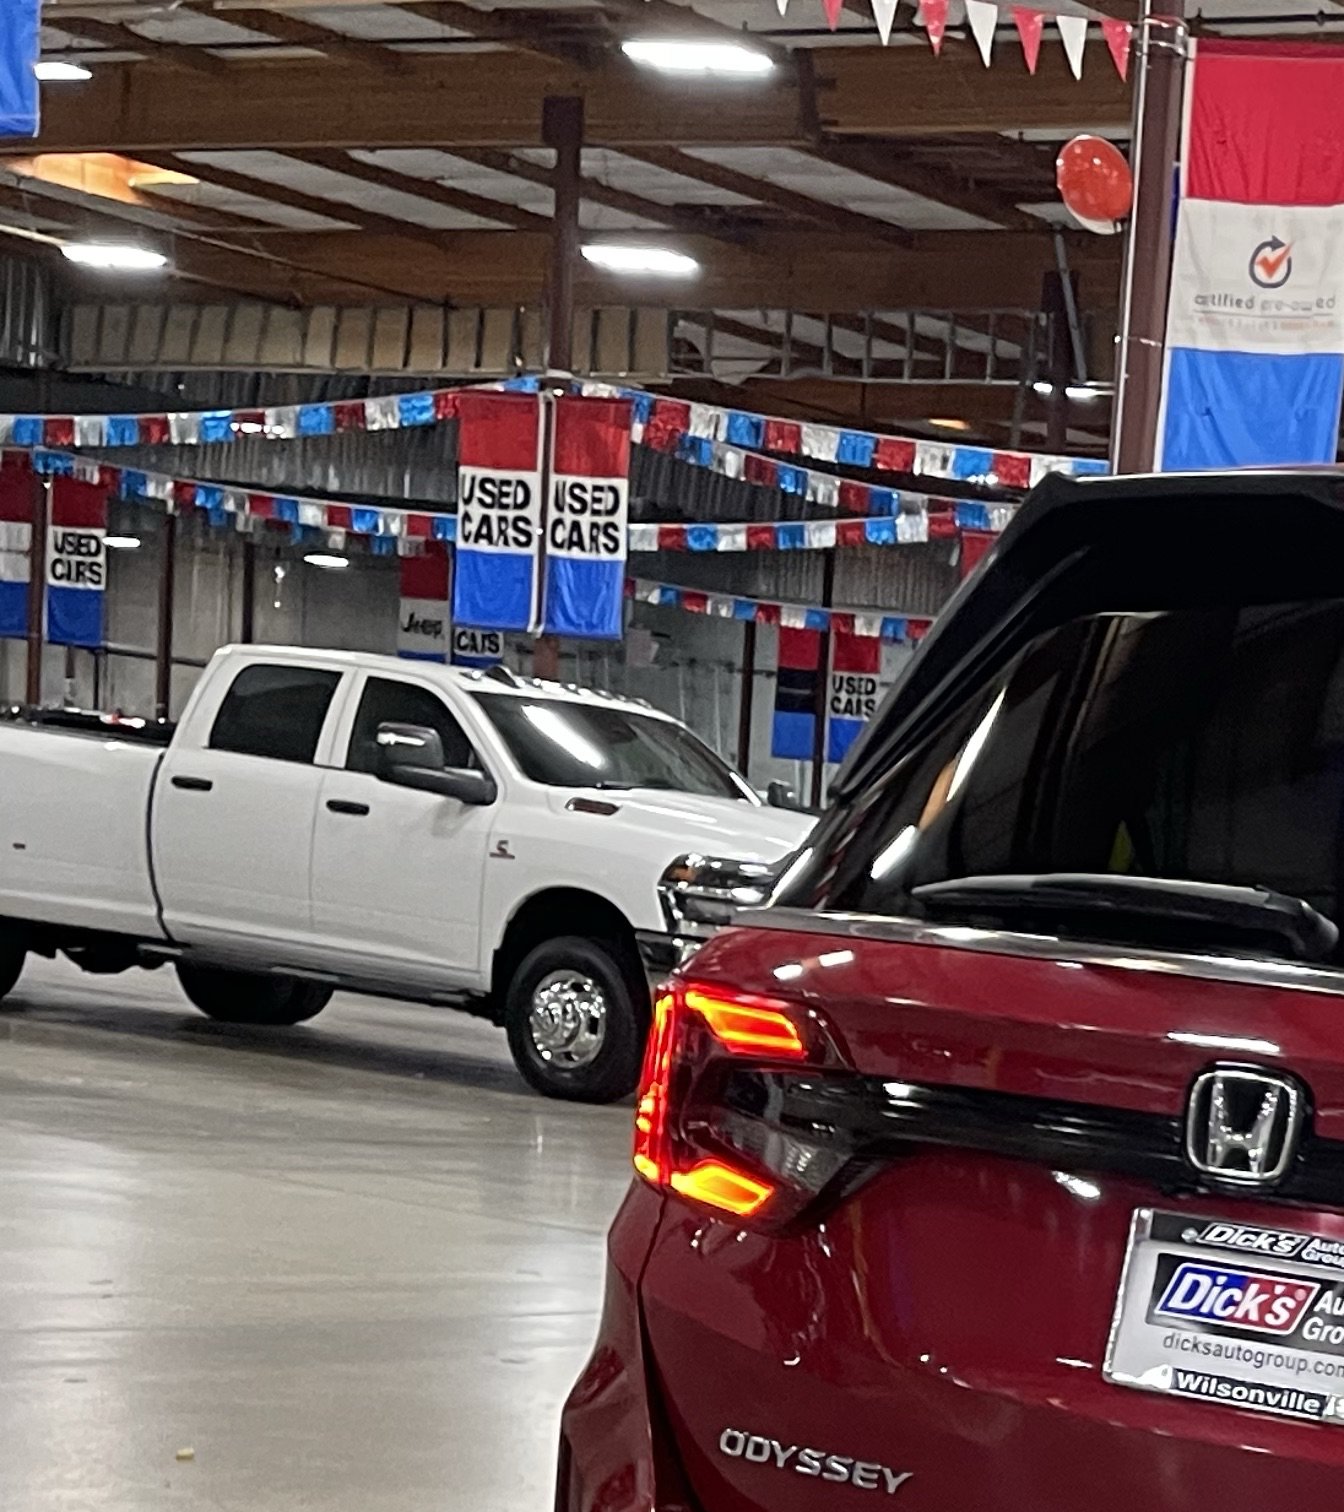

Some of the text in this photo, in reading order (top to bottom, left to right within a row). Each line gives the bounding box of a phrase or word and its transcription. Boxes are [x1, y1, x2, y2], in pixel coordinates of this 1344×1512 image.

[461, 474, 531, 511] USED
[553, 480, 620, 517] USED
[53, 530, 101, 557] USED
[460, 510, 533, 548] CARS
[550, 517, 620, 555] CARS
[832, 674, 877, 696] USED
[1175, 1369, 1323, 1414] Wilsonville
[719, 1427, 914, 1495] ODYSSEY
